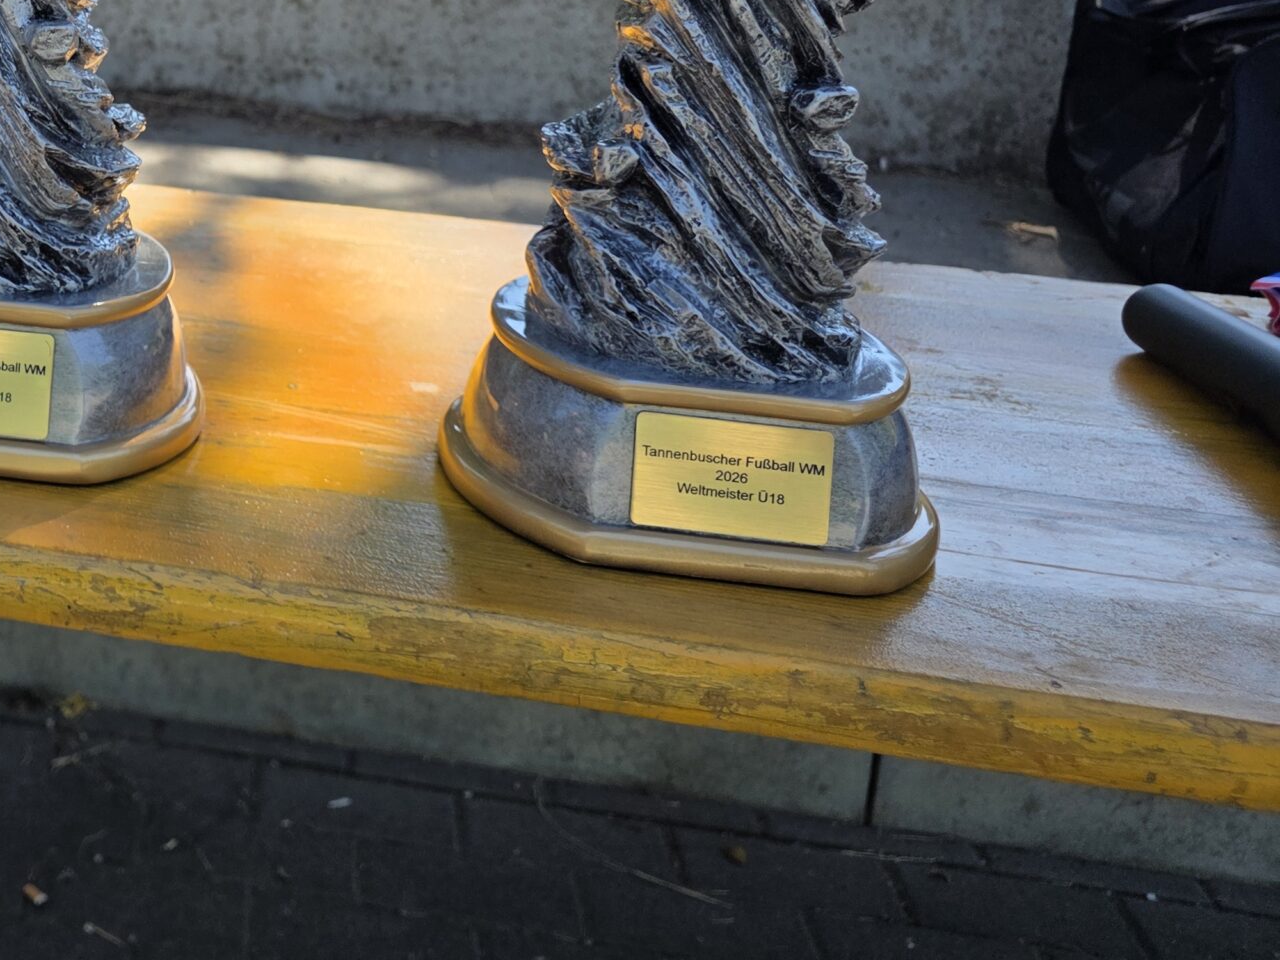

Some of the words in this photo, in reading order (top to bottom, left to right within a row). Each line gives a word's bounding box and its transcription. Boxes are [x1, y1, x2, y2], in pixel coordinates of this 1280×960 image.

[24, 363, 46, 376] WM
[642, 444, 741, 466] Tannenbuscher
[746, 456, 795, 473] Fußball
[799, 463, 825, 476] WM
[715, 470, 748, 484] 2026
[677, 482, 754, 501] Weltmeister
[758, 490, 785, 505] Ü18
